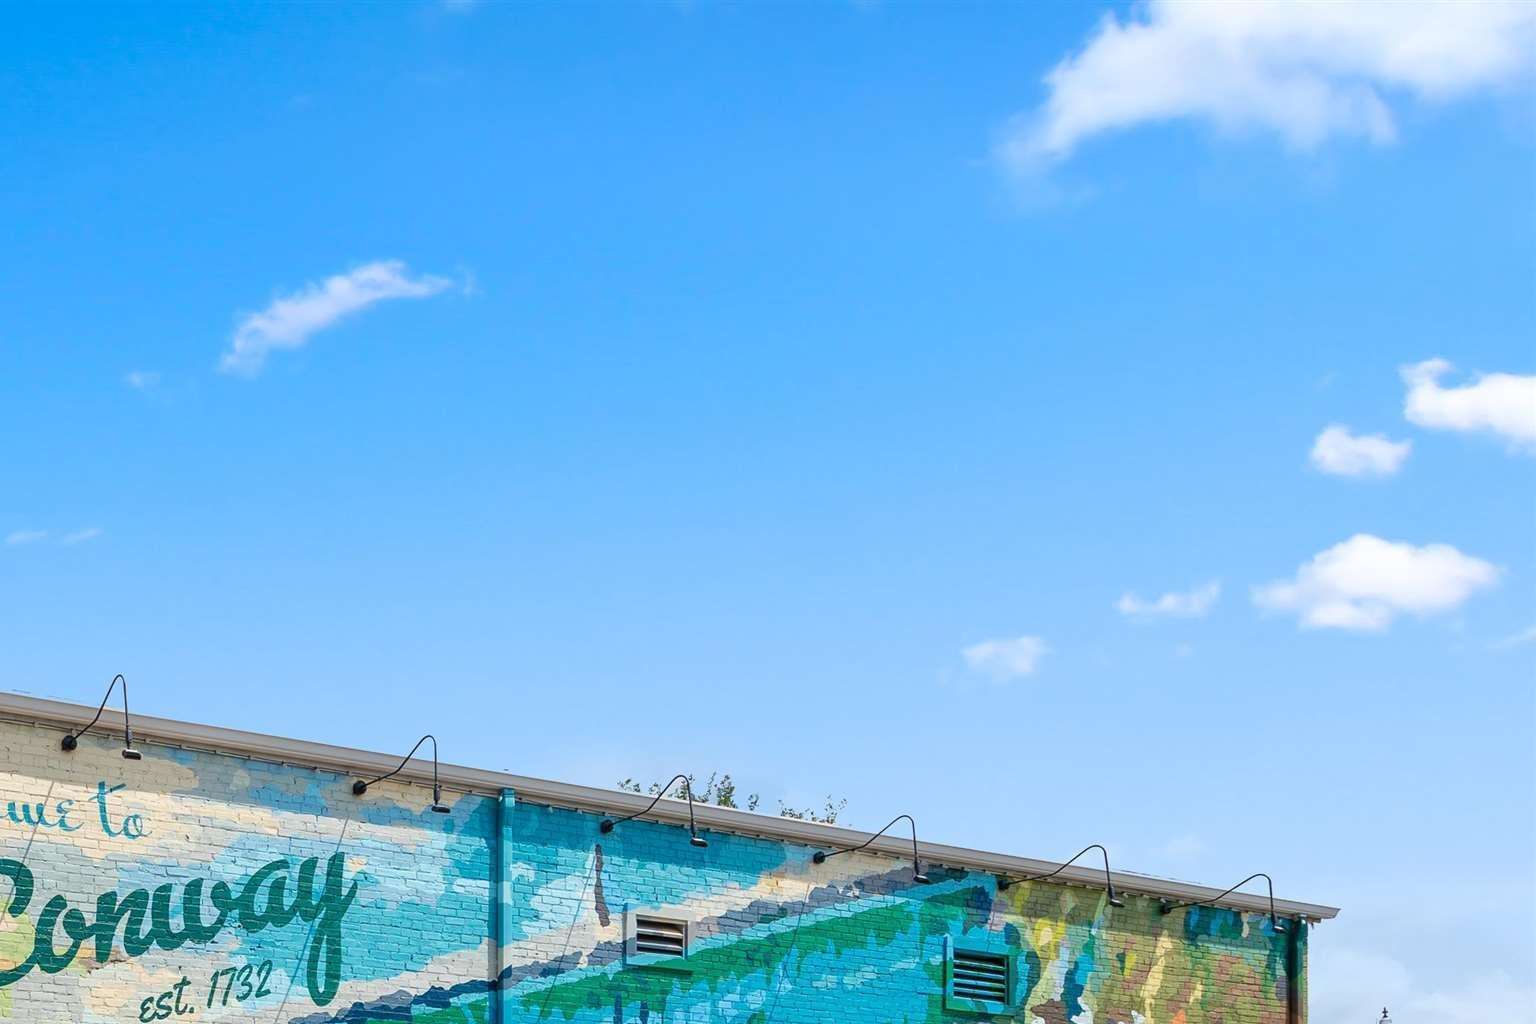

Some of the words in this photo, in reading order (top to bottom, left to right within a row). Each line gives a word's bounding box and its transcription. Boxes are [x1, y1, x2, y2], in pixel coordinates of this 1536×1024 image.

[88, 780, 153, 840] to
[138, 975, 195, 1024] est.
[206, 959, 273, 1009] 1732
